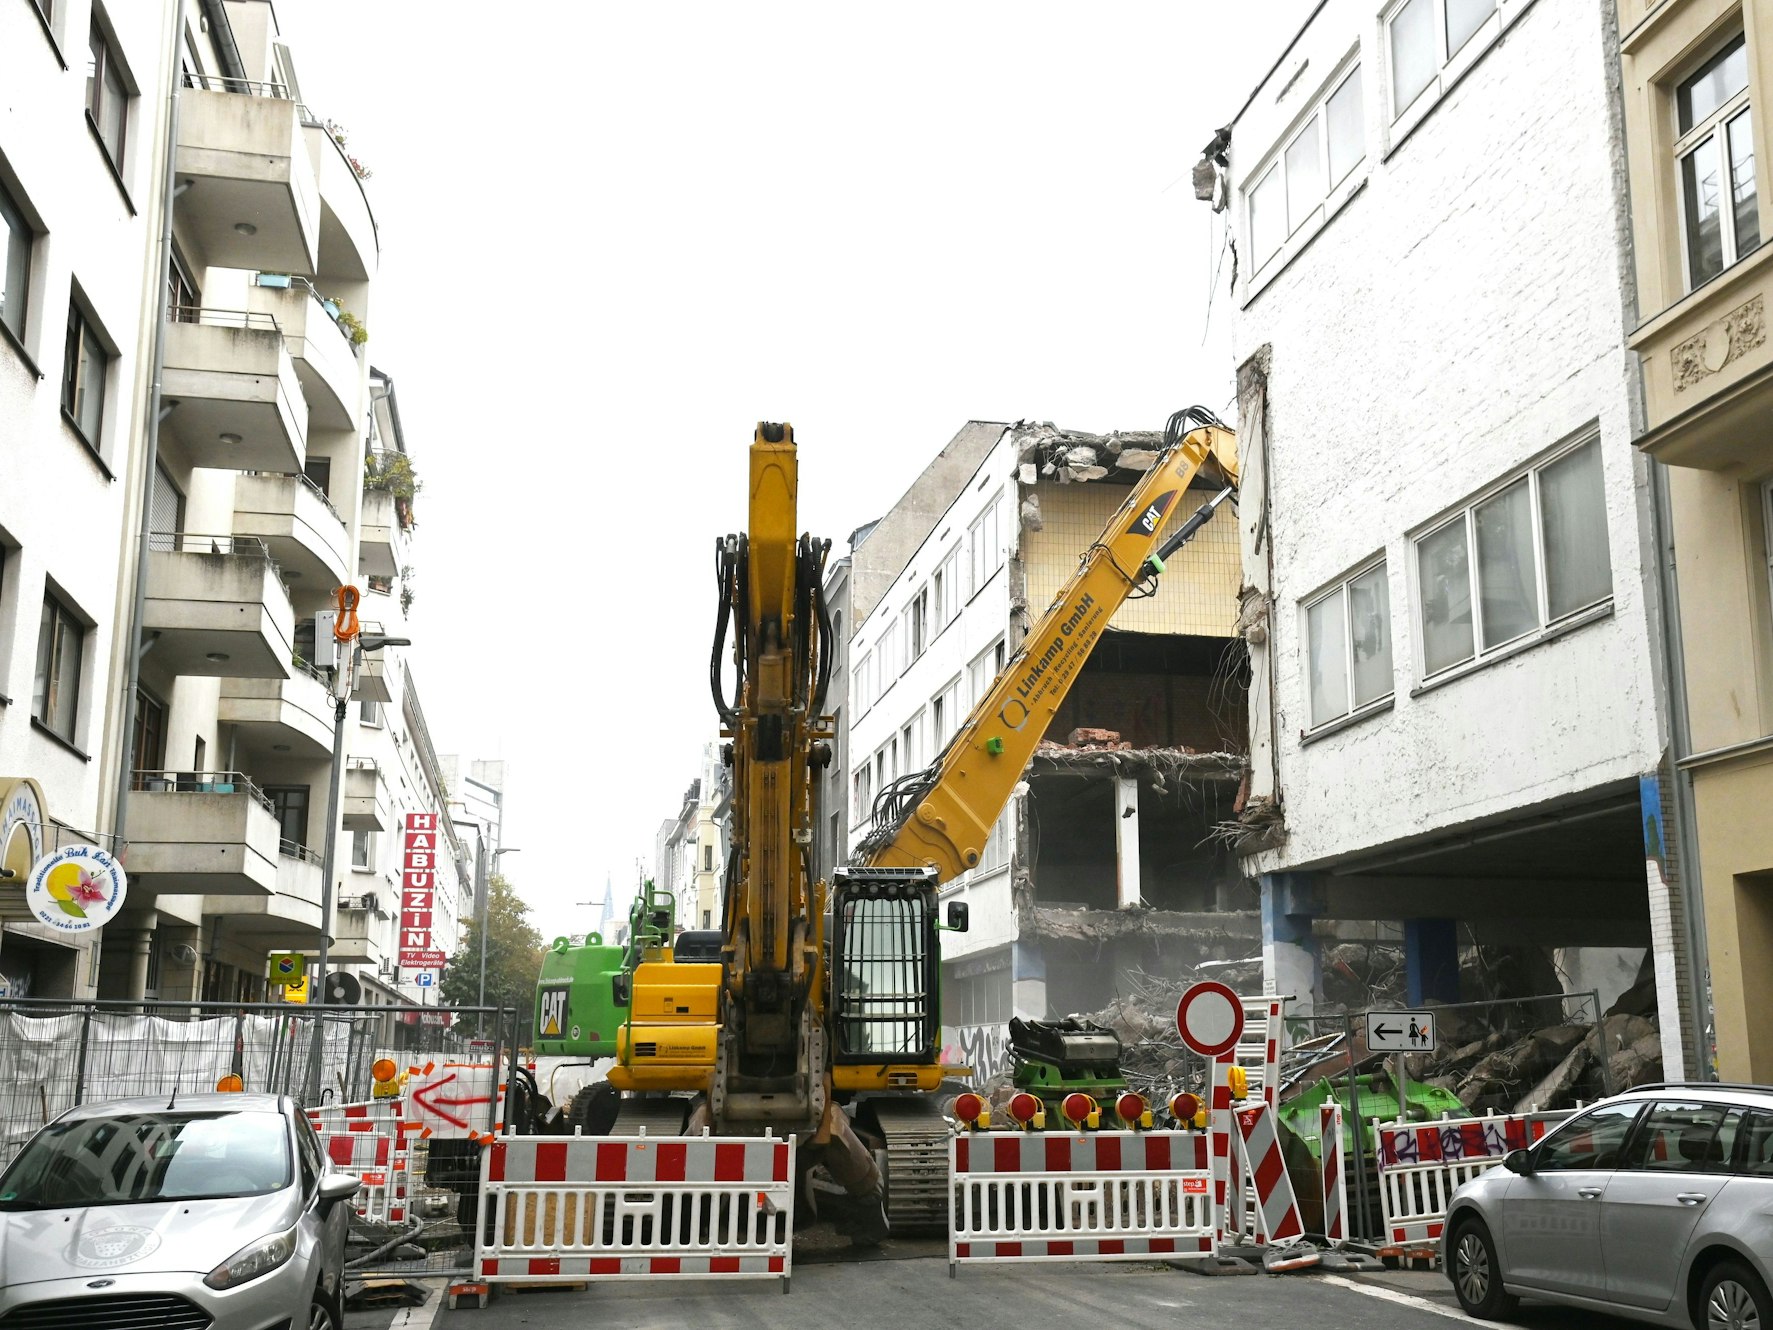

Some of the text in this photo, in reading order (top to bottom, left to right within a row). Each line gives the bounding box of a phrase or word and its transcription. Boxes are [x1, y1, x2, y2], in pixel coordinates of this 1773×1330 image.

[1142, 505, 1162, 531] CAT
[1016, 592, 1095, 698] Linkamp GmbH
[1032, 606, 1104, 704] Abbruch Recycling Sanierung
[105, 867, 119, 912] Thaimassage
[400, 959, 444, 967] Elektrogeräte
[420, 974, 430, 986] P
[540, 991, 566, 1035] CAT
